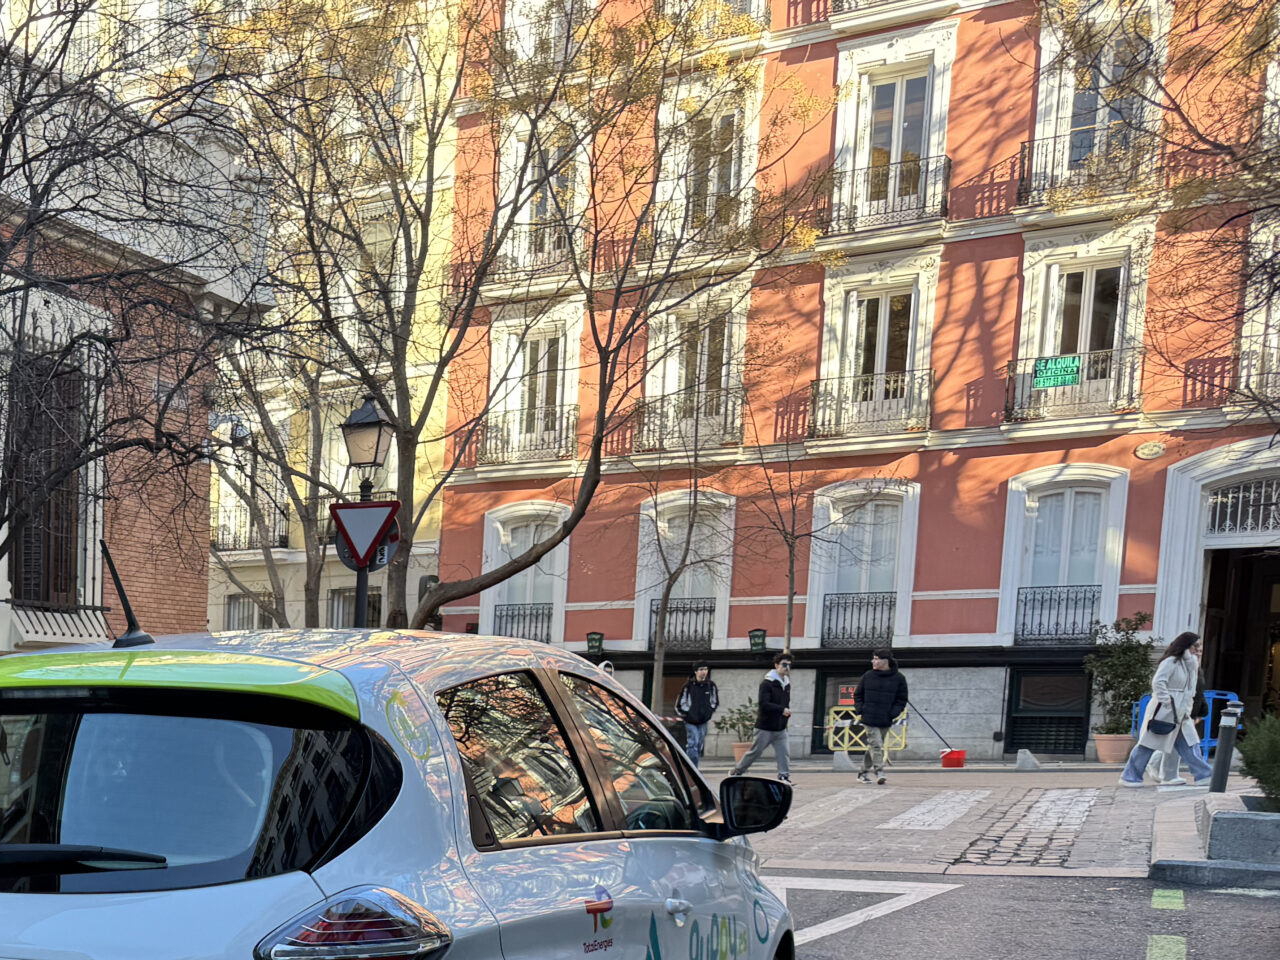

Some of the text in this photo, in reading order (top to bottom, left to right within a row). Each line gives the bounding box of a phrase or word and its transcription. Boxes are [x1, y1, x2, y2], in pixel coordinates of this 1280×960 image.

[1036, 357, 1079, 370] SE ALQUILA
[1039, 368, 1075, 376] OFICINA
[583, 938, 614, 954] TotalEnergies
